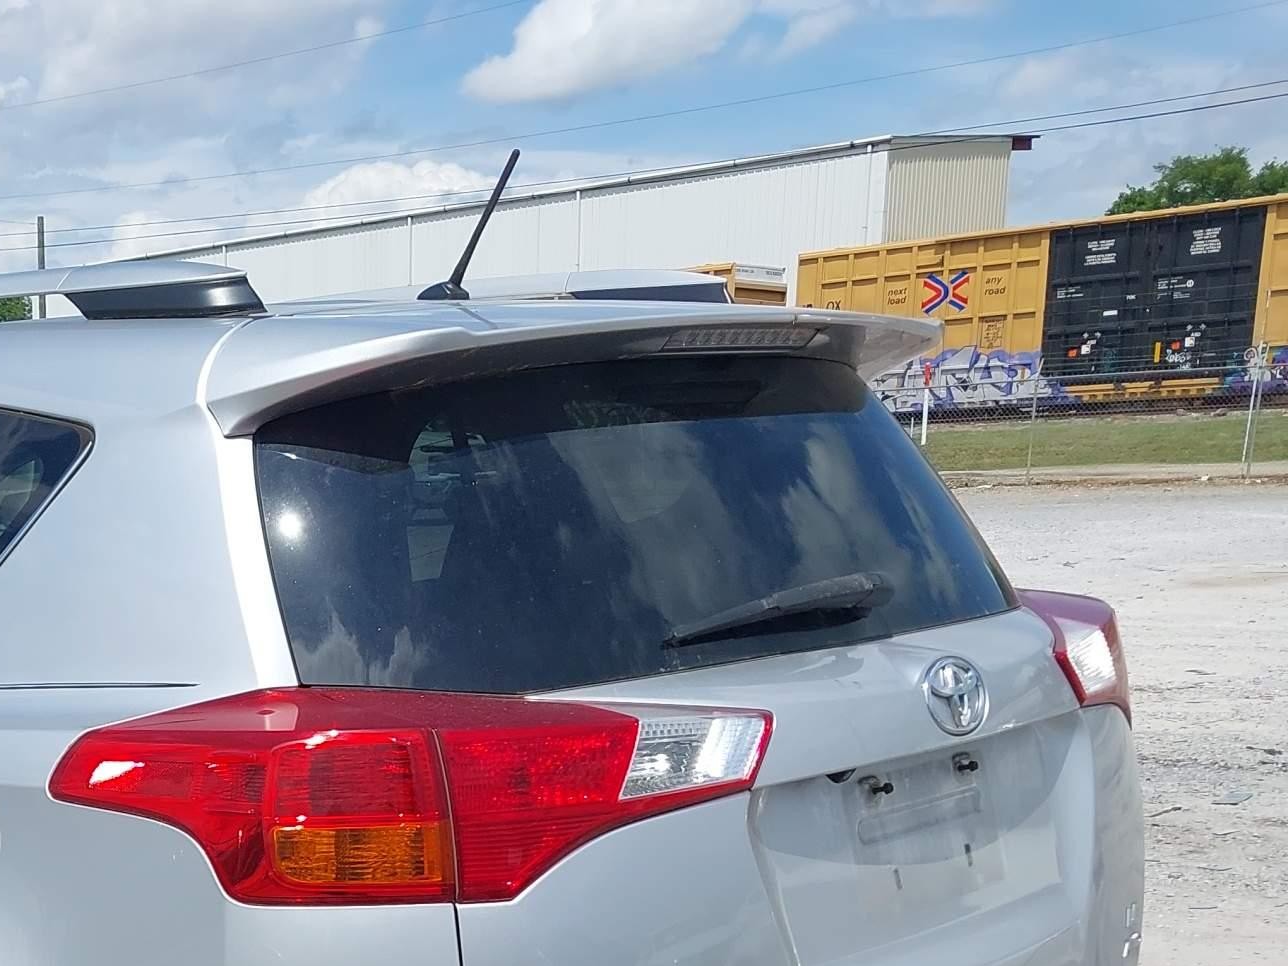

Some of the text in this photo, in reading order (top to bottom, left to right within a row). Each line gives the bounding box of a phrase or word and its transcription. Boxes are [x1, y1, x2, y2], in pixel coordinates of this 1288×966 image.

[985, 275, 1003, 285] any
[887, 287, 907, 296] next
[984, 286, 1006, 296] road
[887, 295, 907, 305] load
